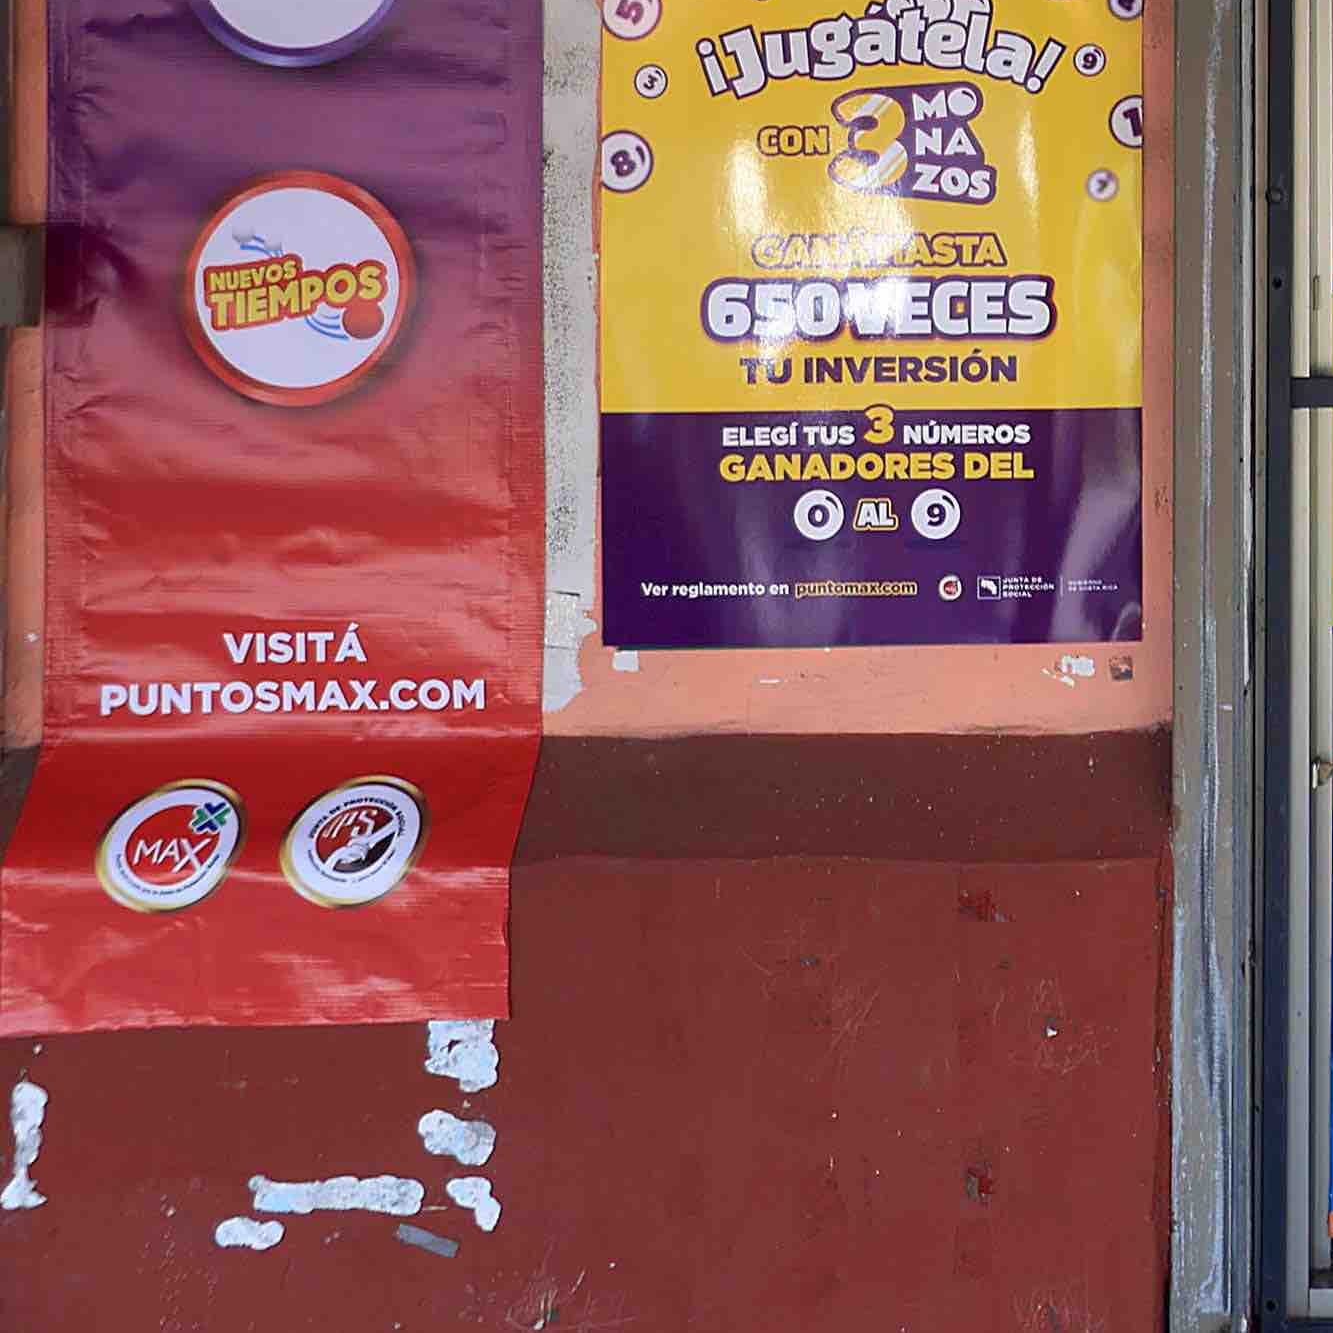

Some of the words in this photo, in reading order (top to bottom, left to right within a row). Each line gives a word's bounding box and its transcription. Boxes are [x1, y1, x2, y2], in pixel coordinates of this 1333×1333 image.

[696, 3, 1066, 100] ¡Jugátela!
[758, 125, 830, 156] CON
[828, 88, 909, 196] 3
[914, 128, 976, 156] NA
[912, 165, 992, 199] ZOS
[205, 258, 301, 295] NUEVOS
[208, 262, 389, 331] TIEMPOS
[701, 276, 842, 342] 650
[846, 276, 1056, 342] VECES
[741, 357, 792, 385] TU
[803, 348, 1017, 385] INVERSIÓN
[722, 421, 797, 447] ELEGÍ
[802, 425, 855, 446] TUS
[863, 404, 895, 445] 3
[903, 419, 1031, 445] NÚMEROS
[720, 453, 955, 482] GANADORES
[963, 452, 1034, 480] DEL
[641, 582, 668, 598] Ver
[671, 582, 765, 601] reglamento
[769, 584, 790, 597] en
[795, 581, 918, 602] puntomax.com
[223, 623, 367, 664] VISITÁ
[101, 678, 486, 716] PUNTOSMAX.COM
[132, 837, 212, 875] MAX
